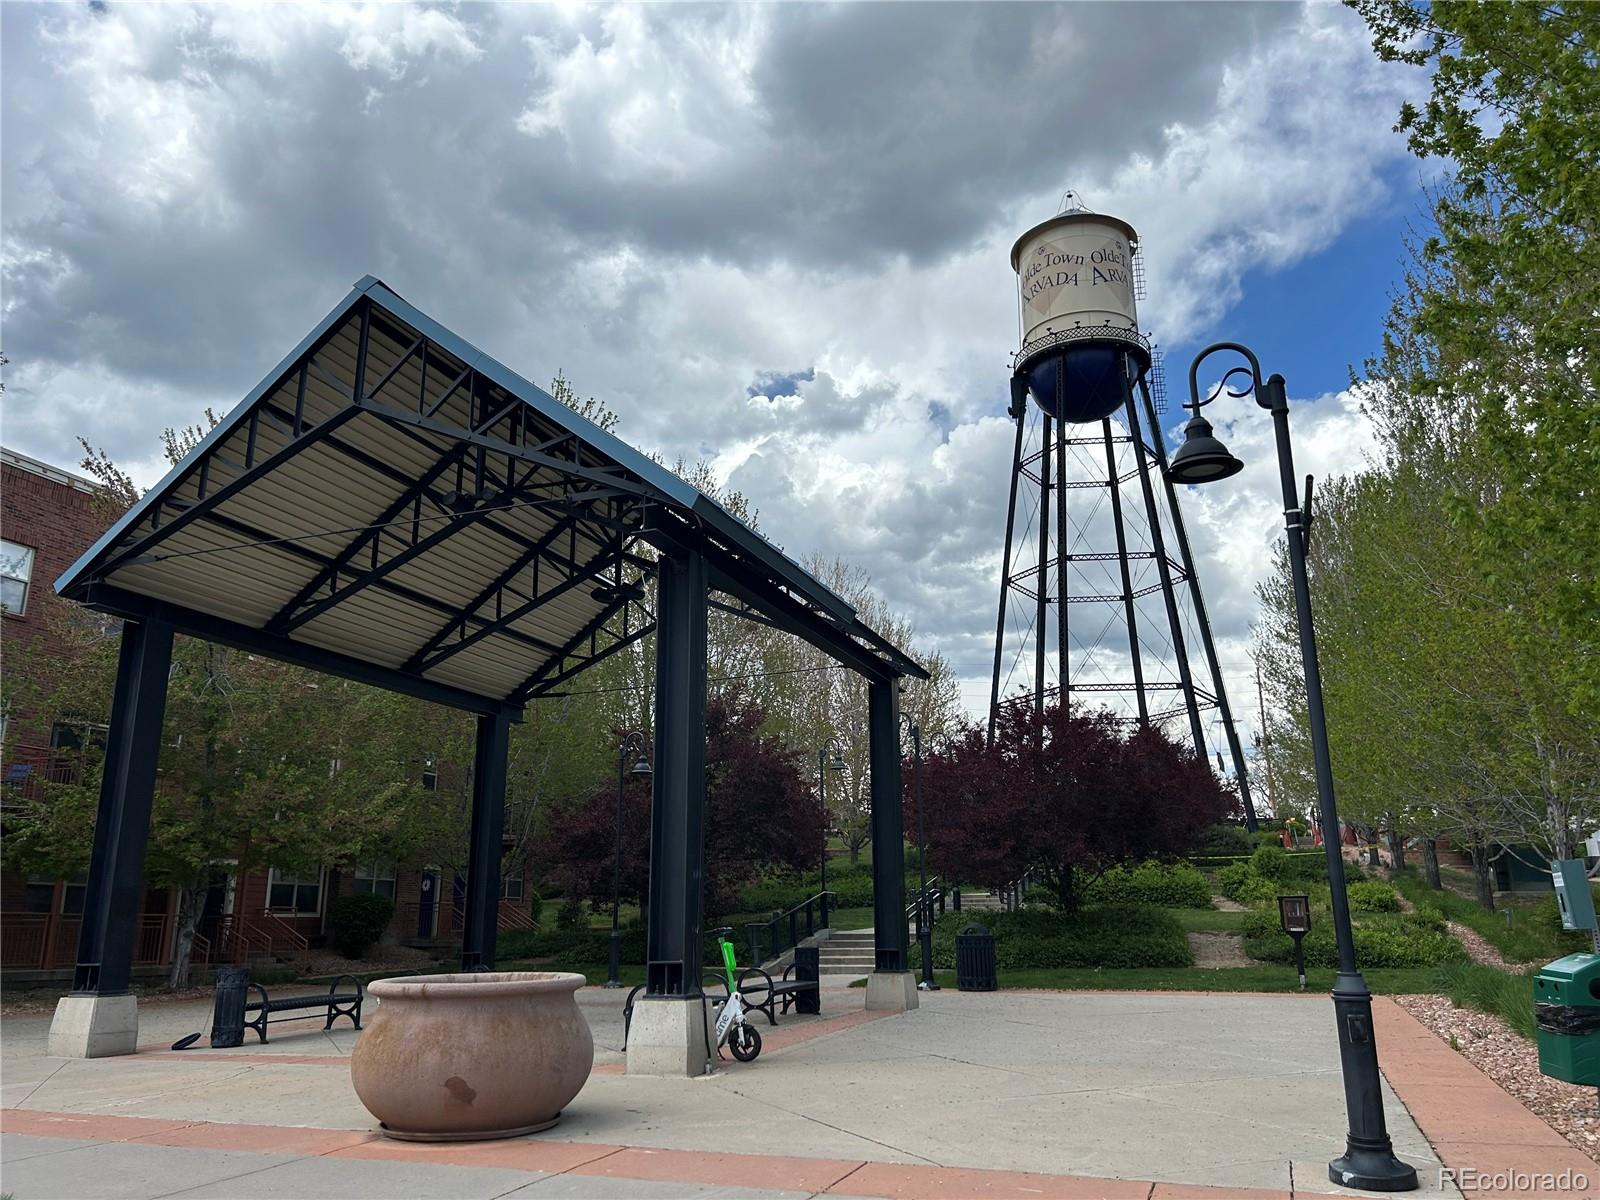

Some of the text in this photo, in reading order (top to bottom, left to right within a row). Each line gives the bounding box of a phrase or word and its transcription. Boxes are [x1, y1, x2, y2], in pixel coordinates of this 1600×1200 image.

[1044, 252, 1084, 267] Town
[1091, 248, 1119, 264] Olde
[1092, 266, 1131, 289] ARVA
[717, 1014, 729, 1036] ime
